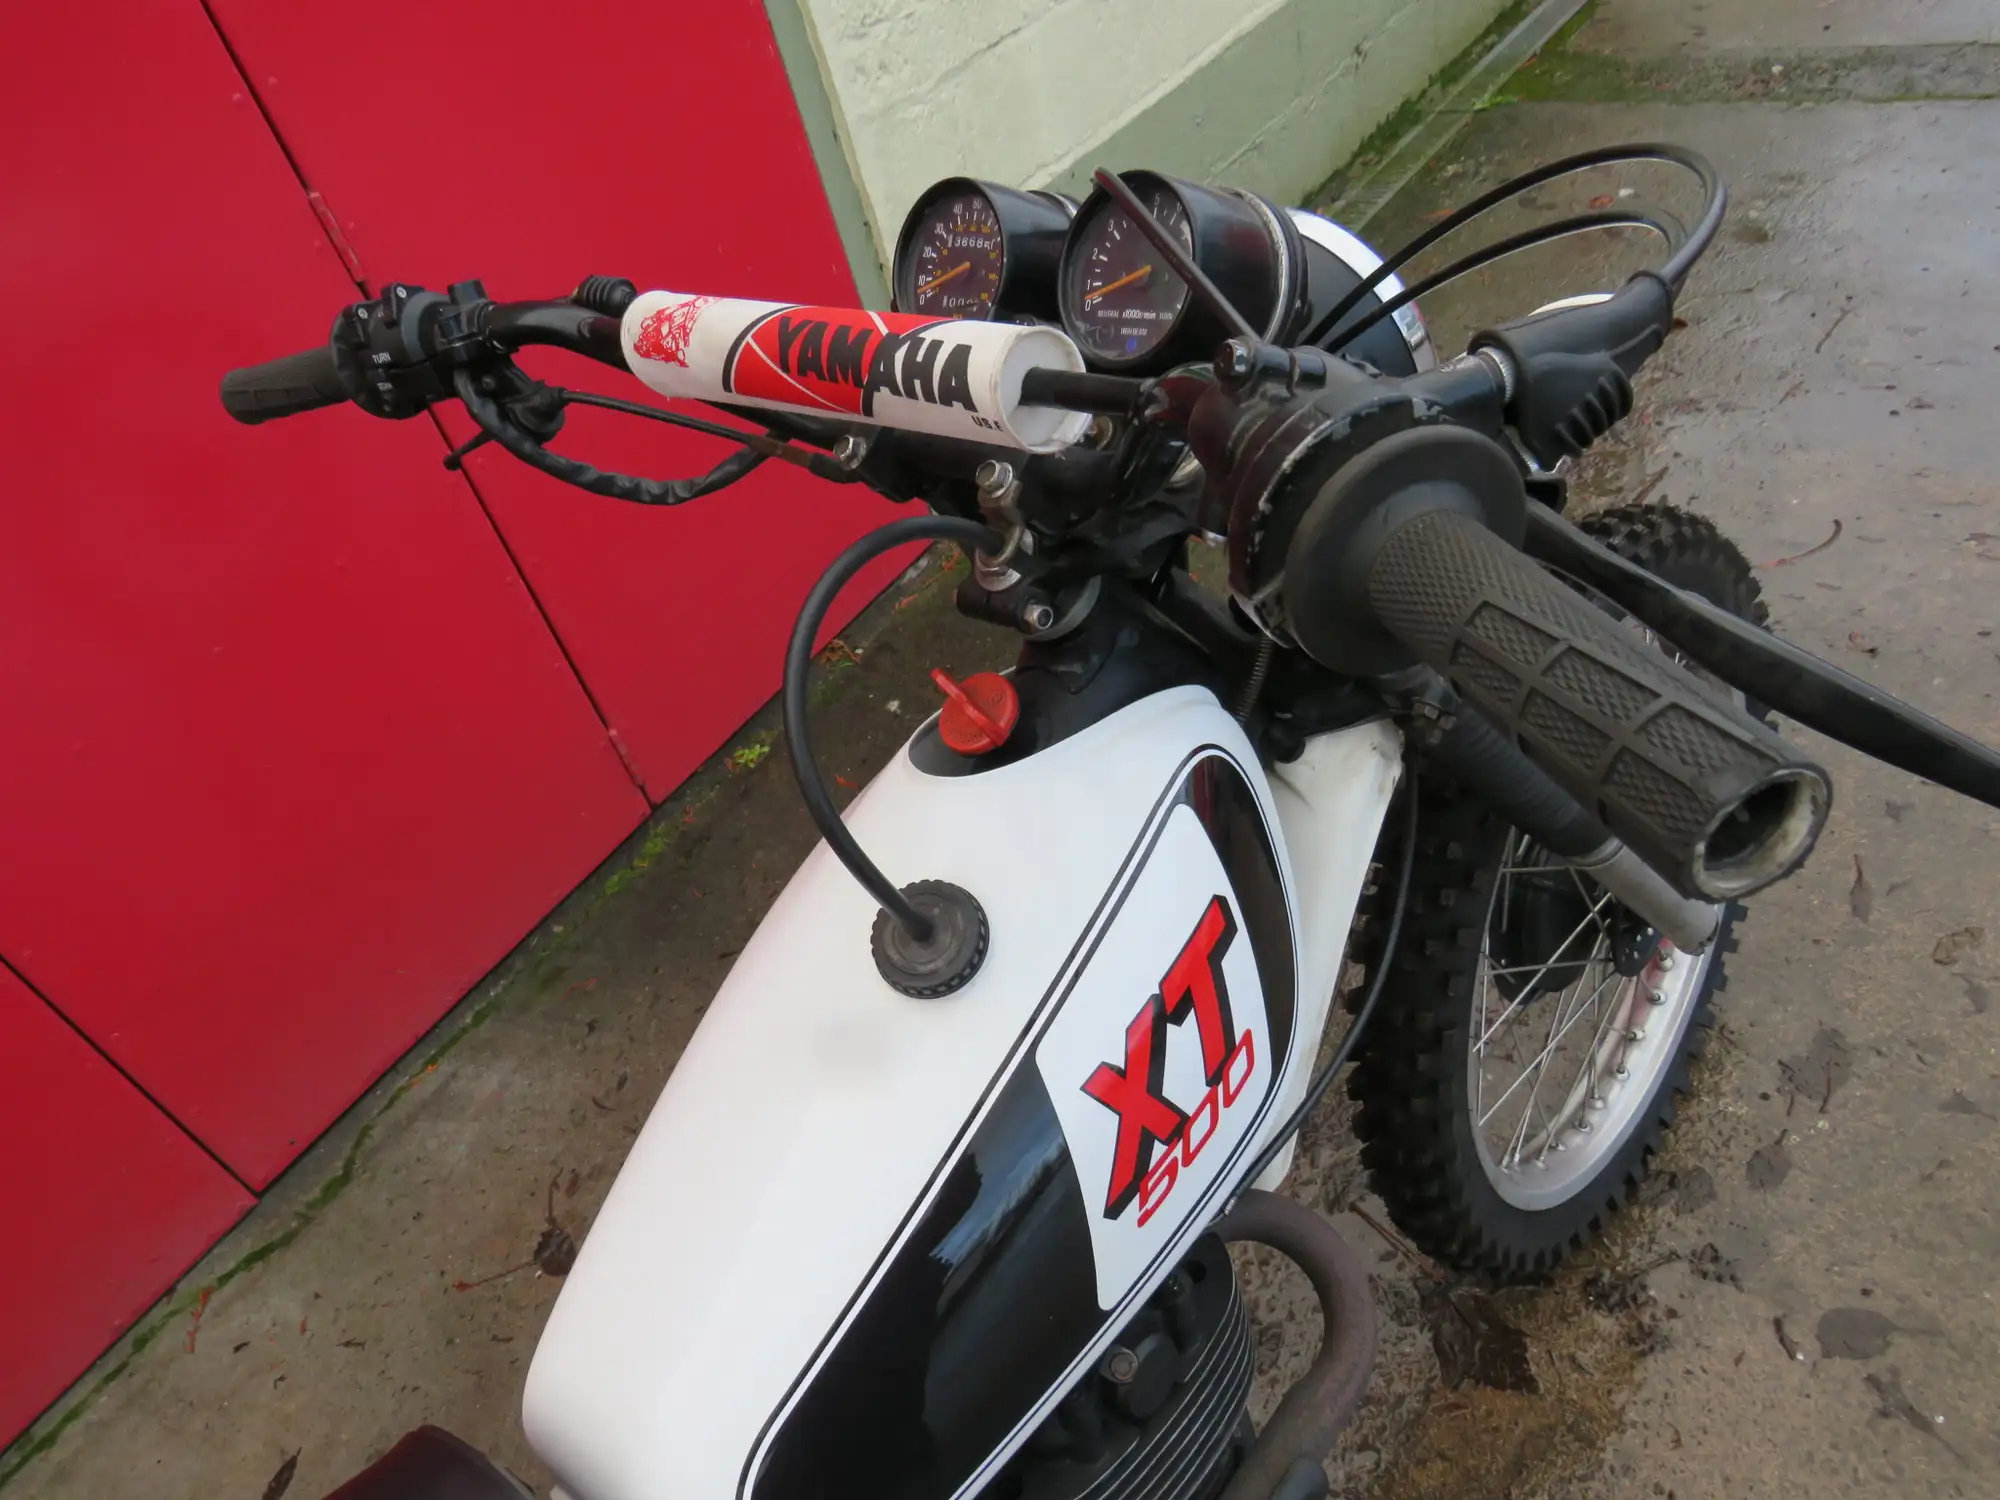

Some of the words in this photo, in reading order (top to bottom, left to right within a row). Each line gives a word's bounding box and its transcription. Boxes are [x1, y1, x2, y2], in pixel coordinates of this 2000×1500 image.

[953, 203, 963, 215] 40
[934, 222, 944, 234] 30
[1108, 219, 1114, 232] 3
[922, 246, 932, 258] 20
[1092, 248, 1098, 260] 2
[918, 274, 926, 286] 10
[919, 294, 926, 306] 0
[1084, 300, 1091, 312] 0
[372, 352, 392, 365] TURN
[777, 316, 979, 415] YAMAHA
[1079, 893, 1238, 1220] XT
[1136, 1028, 1255, 1228] 500
